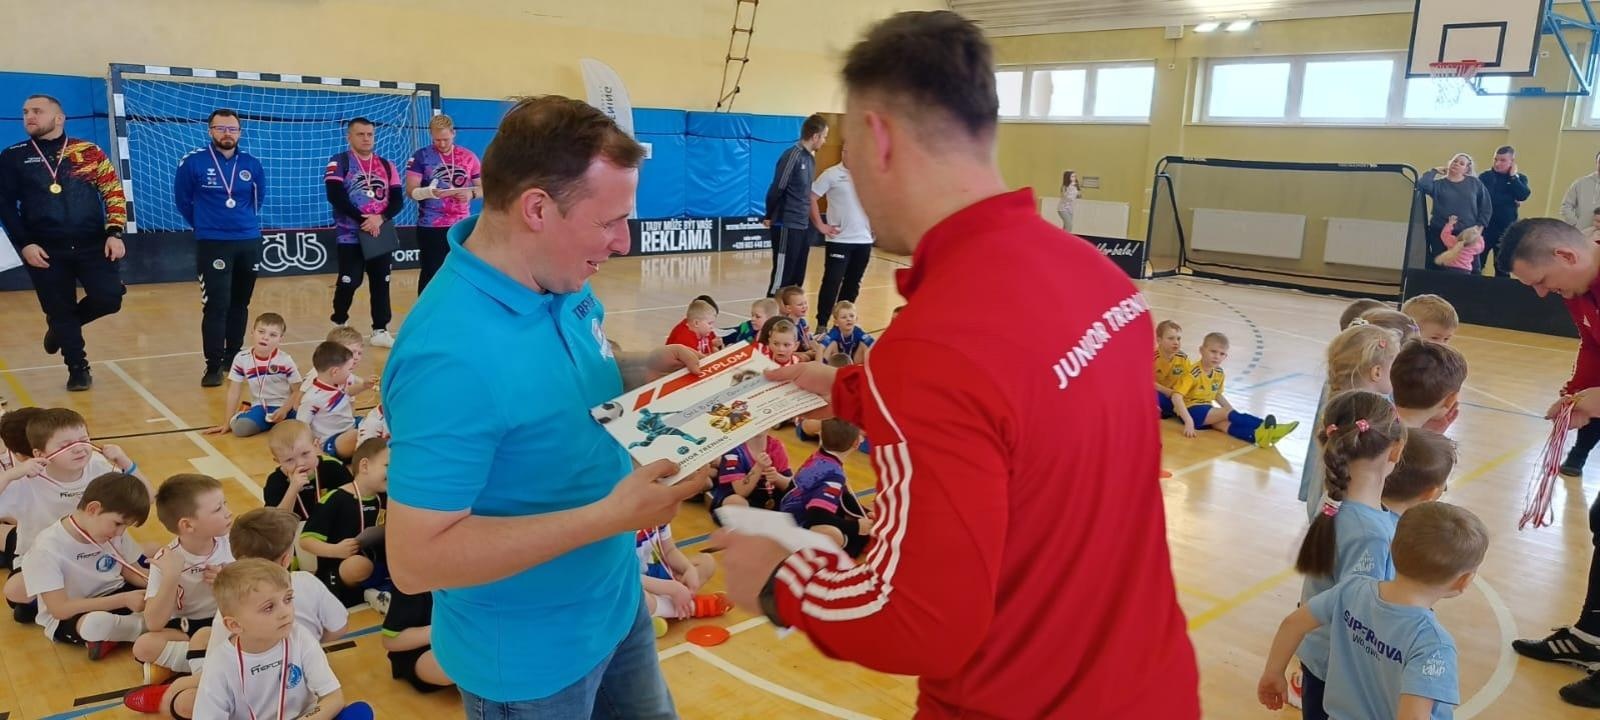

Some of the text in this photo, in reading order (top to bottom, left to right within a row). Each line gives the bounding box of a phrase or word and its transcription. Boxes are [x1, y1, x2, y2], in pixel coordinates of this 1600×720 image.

[641, 229, 713, 252] REKLAMA
[392, 249, 421, 263] ORT
[1052, 321, 1111, 389] JUNIOR
